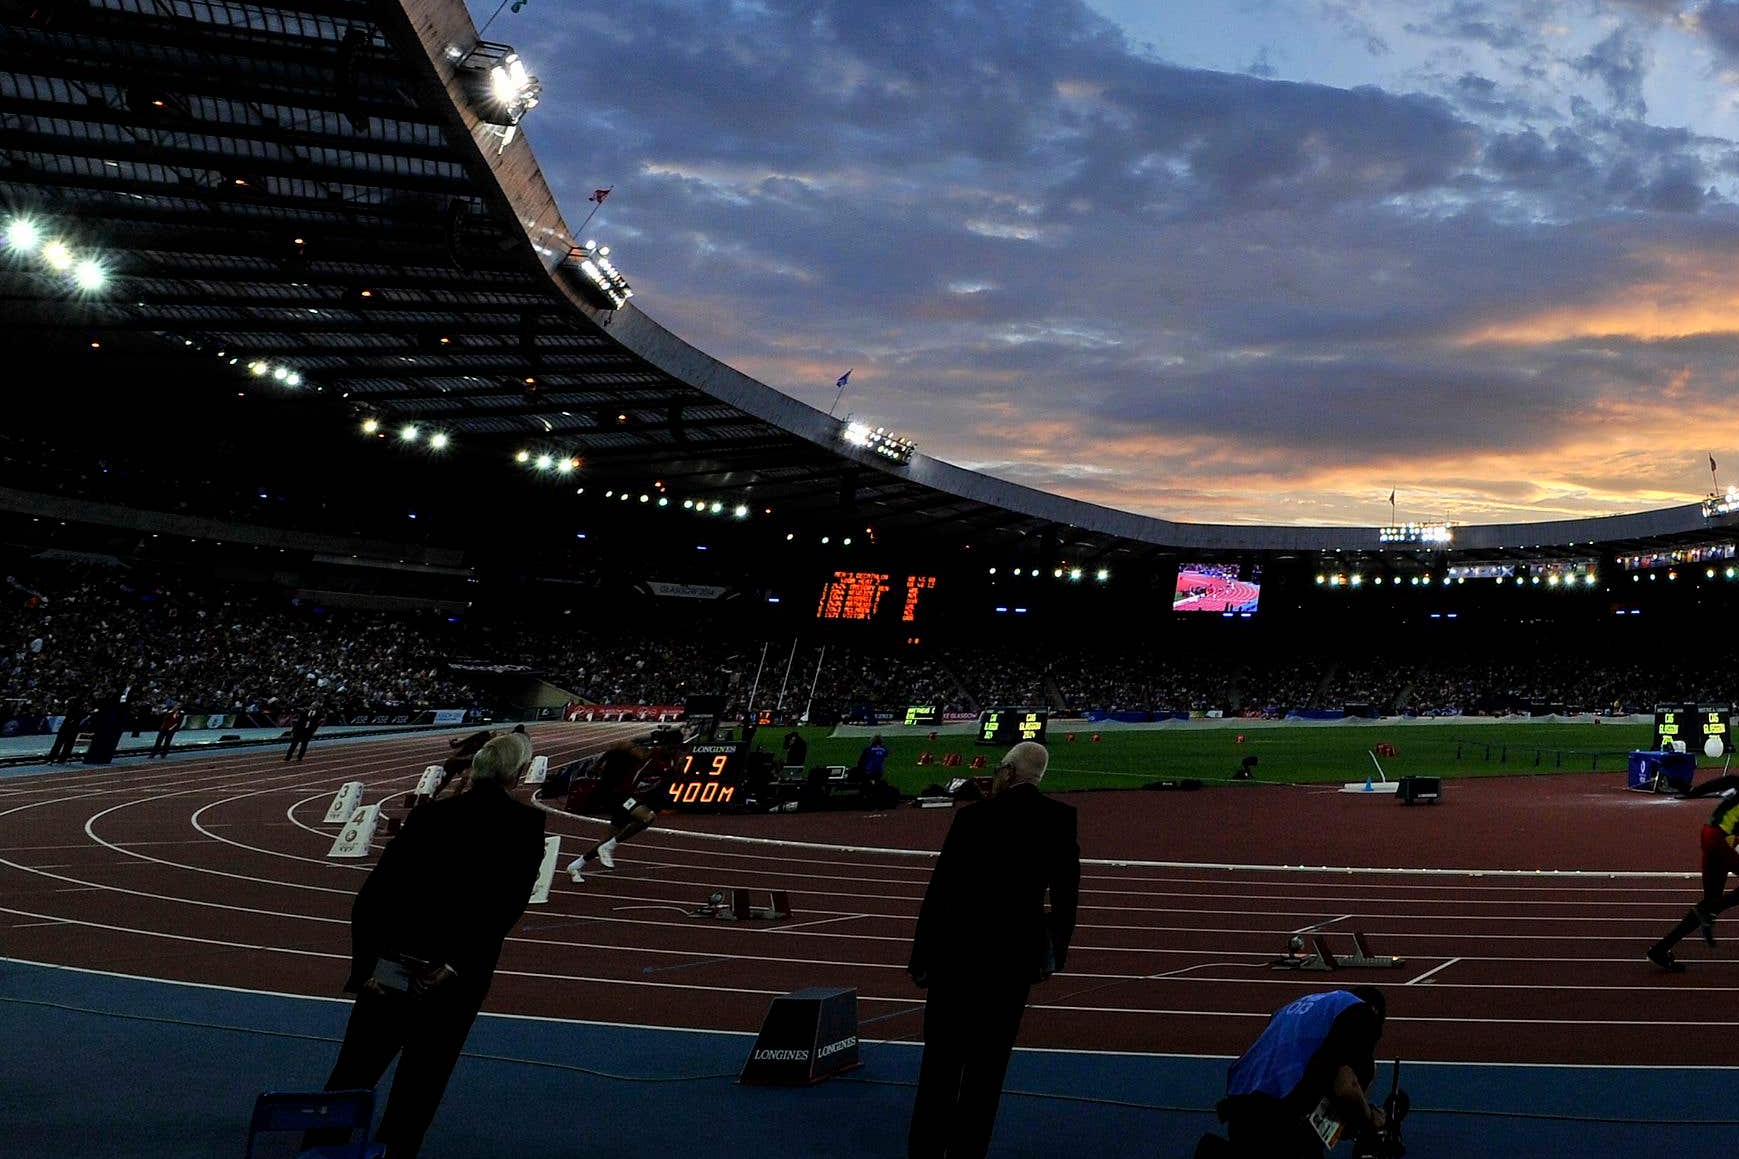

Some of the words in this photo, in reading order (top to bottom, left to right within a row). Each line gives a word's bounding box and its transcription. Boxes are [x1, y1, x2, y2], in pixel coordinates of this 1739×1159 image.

[692, 745, 737, 754] LONGINES
[683, 755, 729, 776] 1.9
[339, 785, 348, 798] 3
[352, 810, 367, 826] 4
[817, 1035, 857, 1058] LONGINES
[754, 1049, 809, 1061] LONGINES
